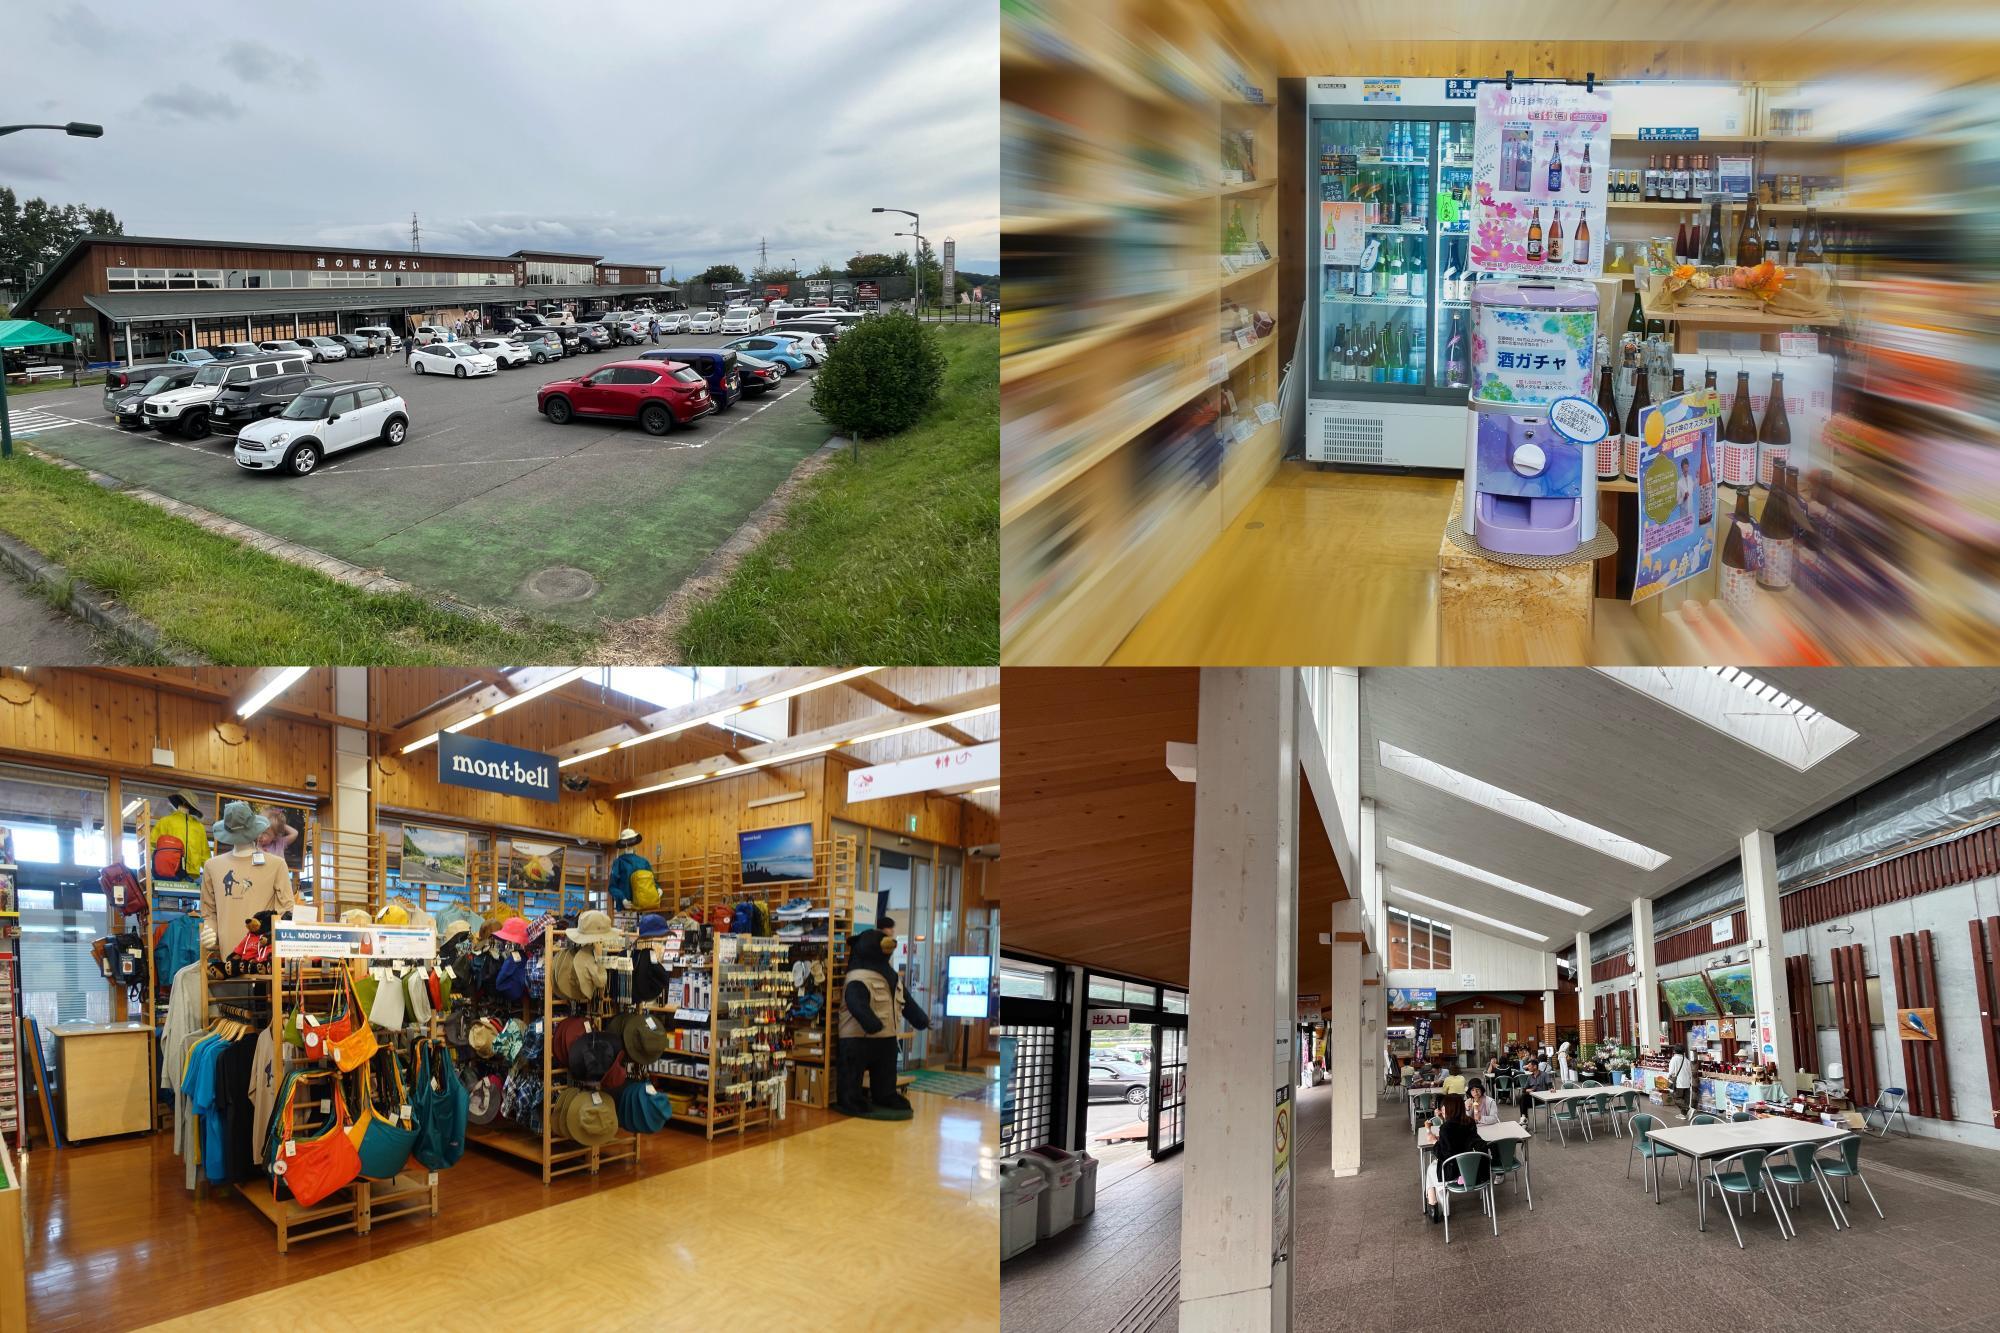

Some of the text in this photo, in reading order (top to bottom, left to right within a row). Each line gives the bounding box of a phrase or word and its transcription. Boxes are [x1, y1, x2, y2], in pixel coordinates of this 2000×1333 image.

[317, 257, 420, 270] 道の駅ばんだい
[1497, 351, 1567, 370] 酒ガチャ
[1092, 1014, 1127, 1025] 出入口
